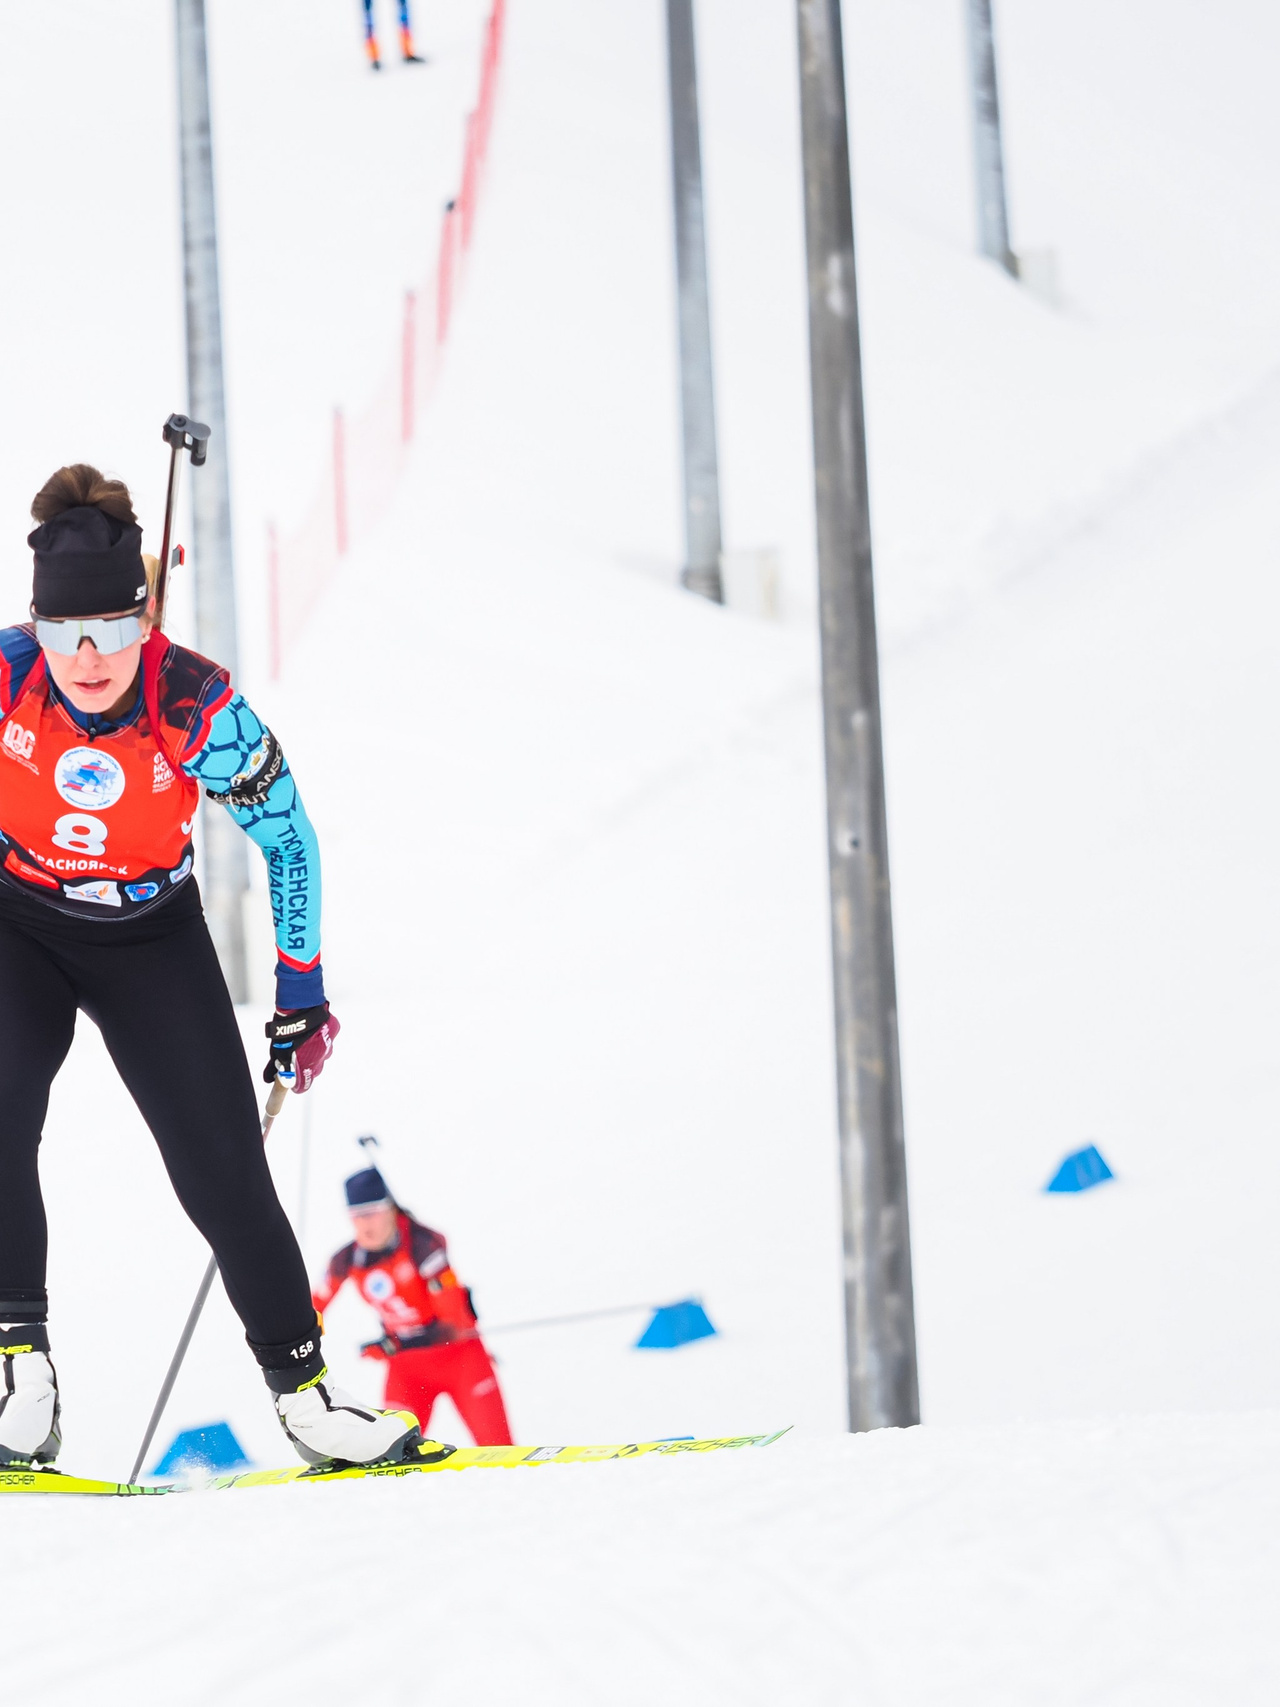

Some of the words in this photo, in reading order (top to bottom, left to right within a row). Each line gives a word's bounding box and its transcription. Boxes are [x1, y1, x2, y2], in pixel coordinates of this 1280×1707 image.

[51, 813, 108, 856] 8
[276, 823, 309, 950] ТЮМЕНСКАЯ
[290, 1340, 315, 1360] 158
[296, 1365, 329, 1393] FISC
[0, 1474, 36, 1486] FISCHER
